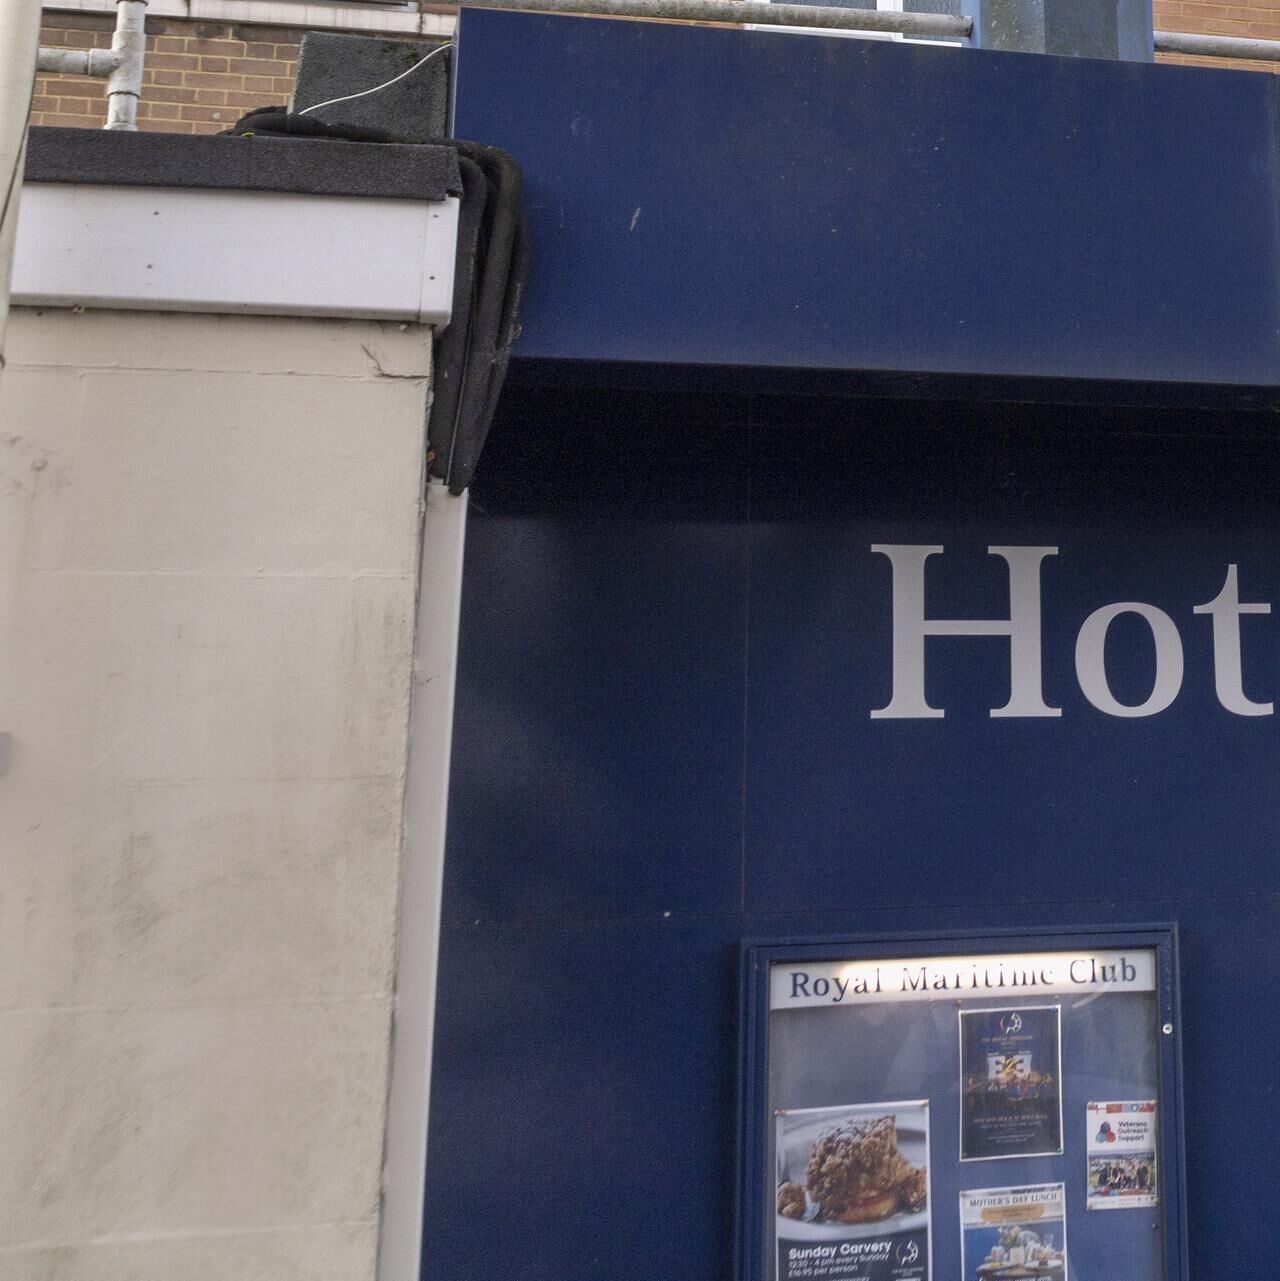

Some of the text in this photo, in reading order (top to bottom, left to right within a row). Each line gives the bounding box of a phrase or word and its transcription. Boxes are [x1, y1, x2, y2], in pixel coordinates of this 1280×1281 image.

[790, 957, 1137, 1003] Royal Maritime Club
[969, 1193, 1057, 1208] MOTHER'S DAY LUNCH
[788, 1241, 892, 1260] Sunday Carvery
[835, 1254, 859, 1266] every
[859, 1252, 889, 1263] Sunday
[813, 1267, 829, 1277] per
[829, 1264, 858, 1275] person
